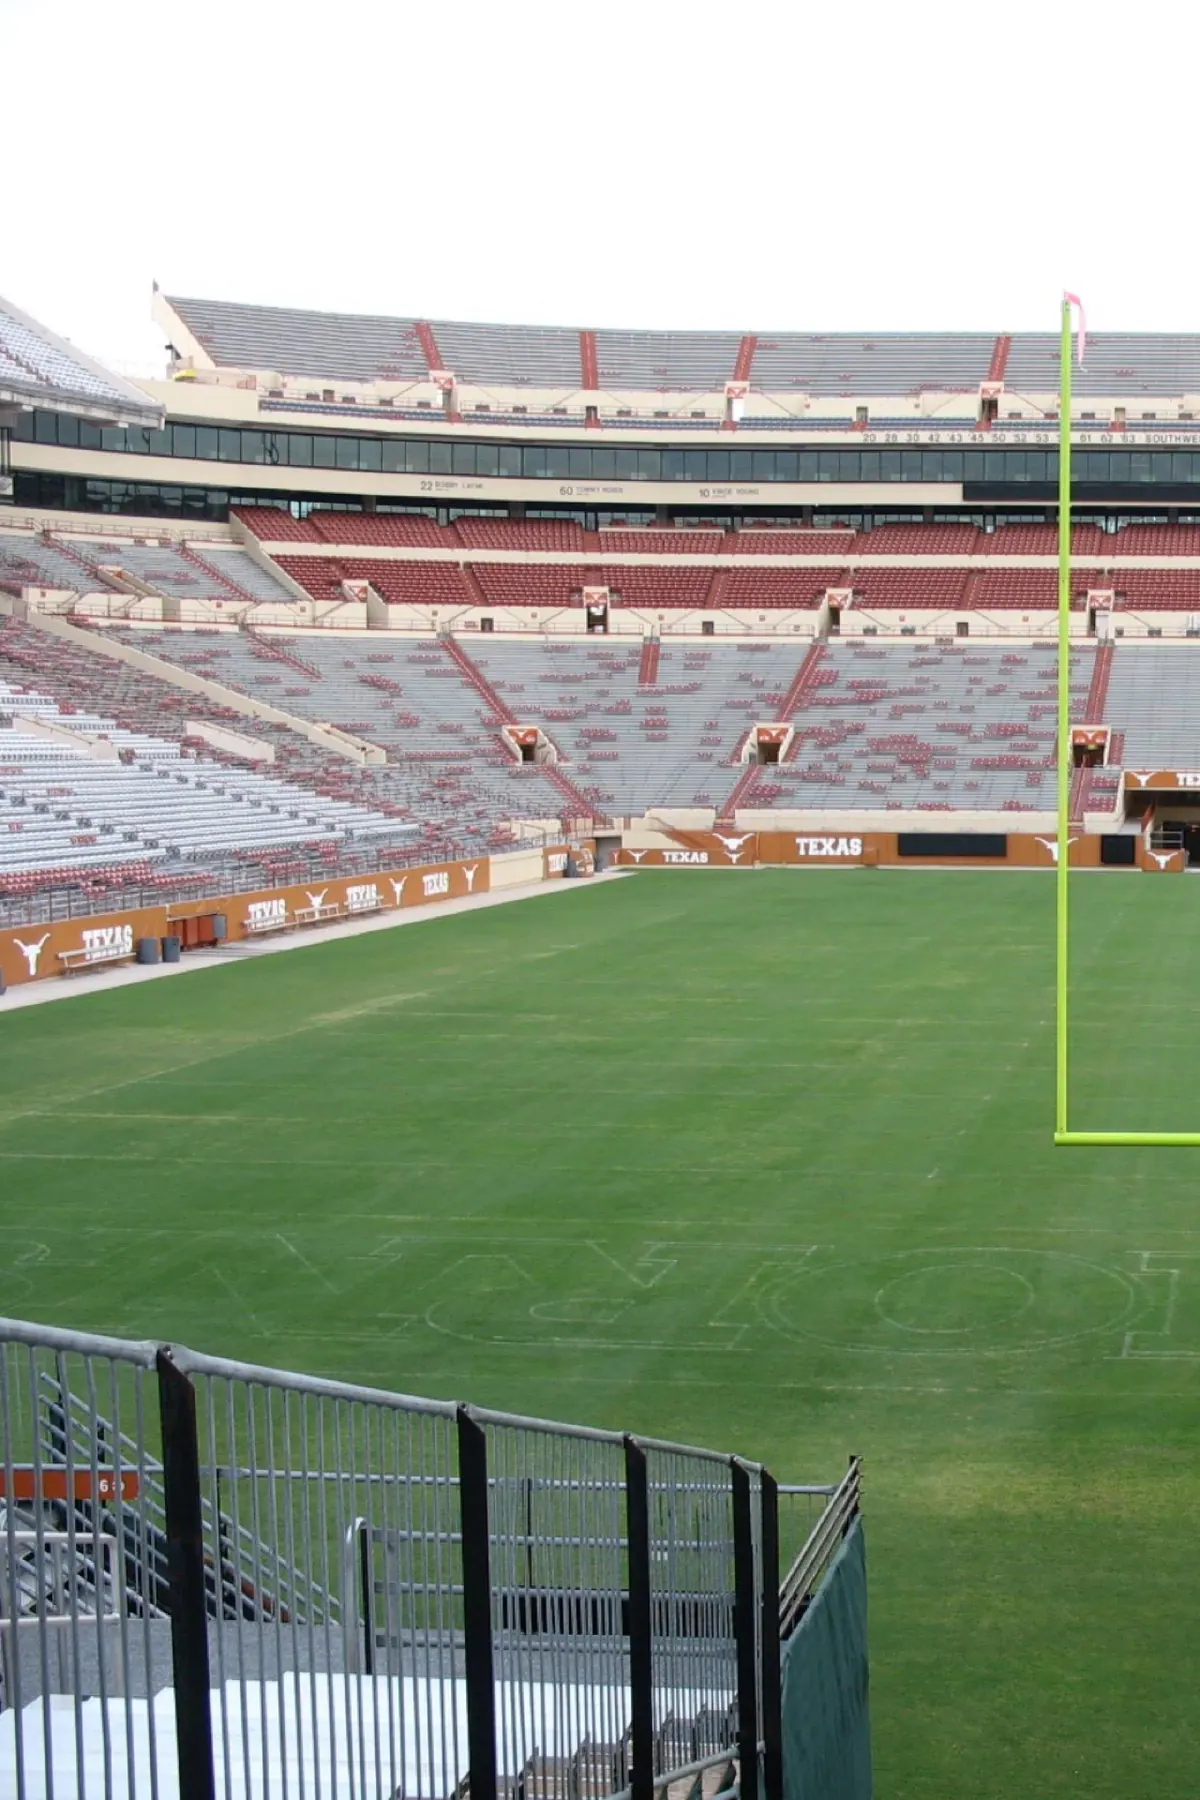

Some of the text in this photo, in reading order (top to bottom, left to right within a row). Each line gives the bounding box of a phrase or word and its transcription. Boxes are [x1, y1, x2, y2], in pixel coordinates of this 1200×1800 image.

[421, 481, 433, 491] 22
[560, 487, 574, 495] 60
[663, 851, 708, 863] TEXAS
[795, 837, 862, 856] TEXAS
[422, 872, 449, 896] TEXAS
[346, 883, 379, 911] TEXAS
[249, 898, 286, 930] TEXAS
[82, 924, 133, 961] TEXAS
